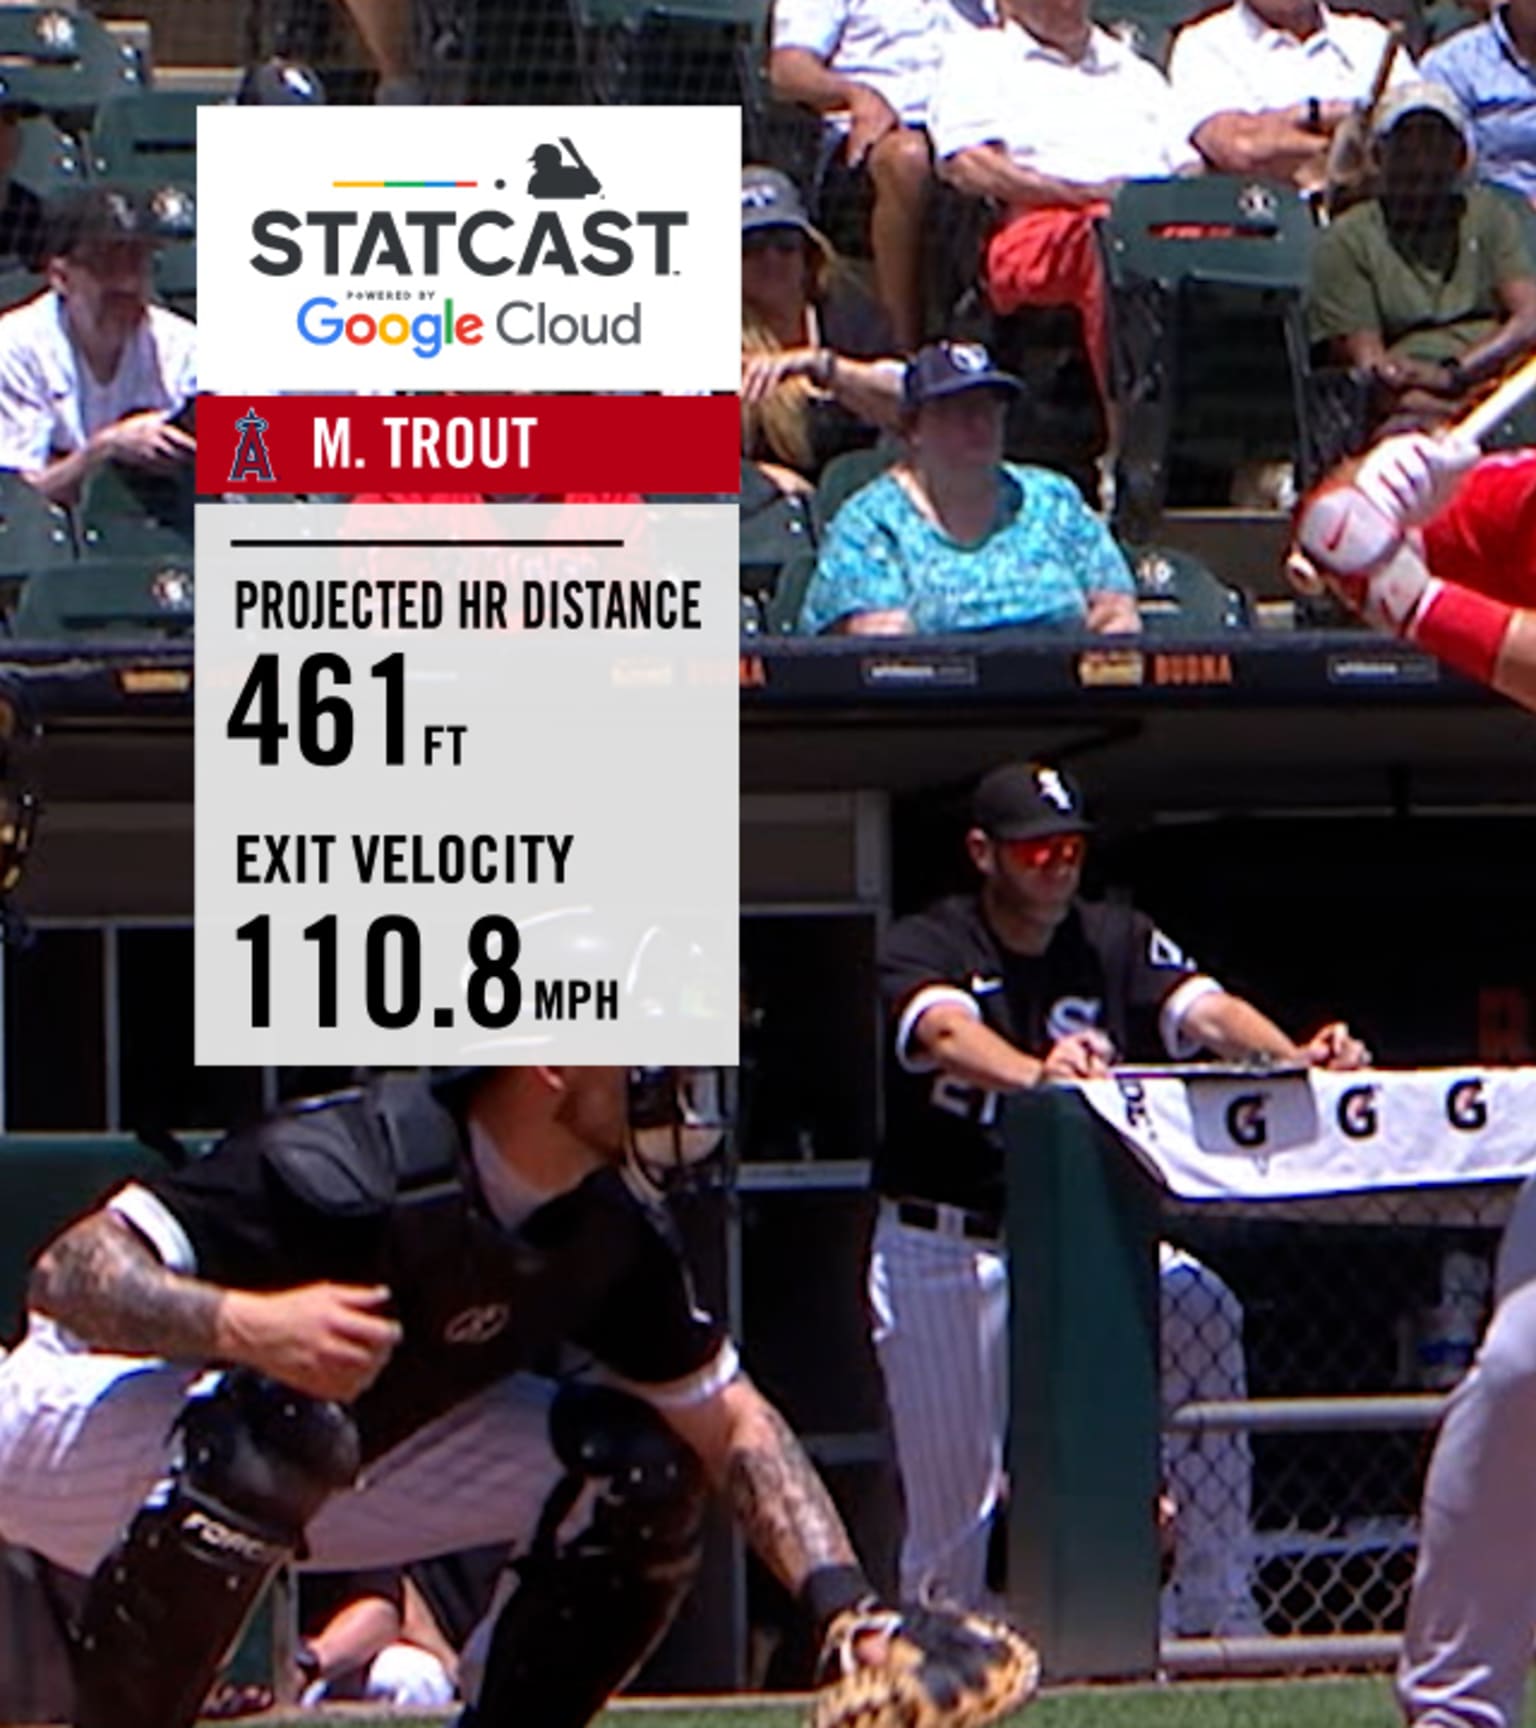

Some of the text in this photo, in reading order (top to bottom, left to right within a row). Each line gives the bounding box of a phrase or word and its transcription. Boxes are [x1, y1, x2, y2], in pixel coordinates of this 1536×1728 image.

[1226, 1077, 1488, 1148] G G G
